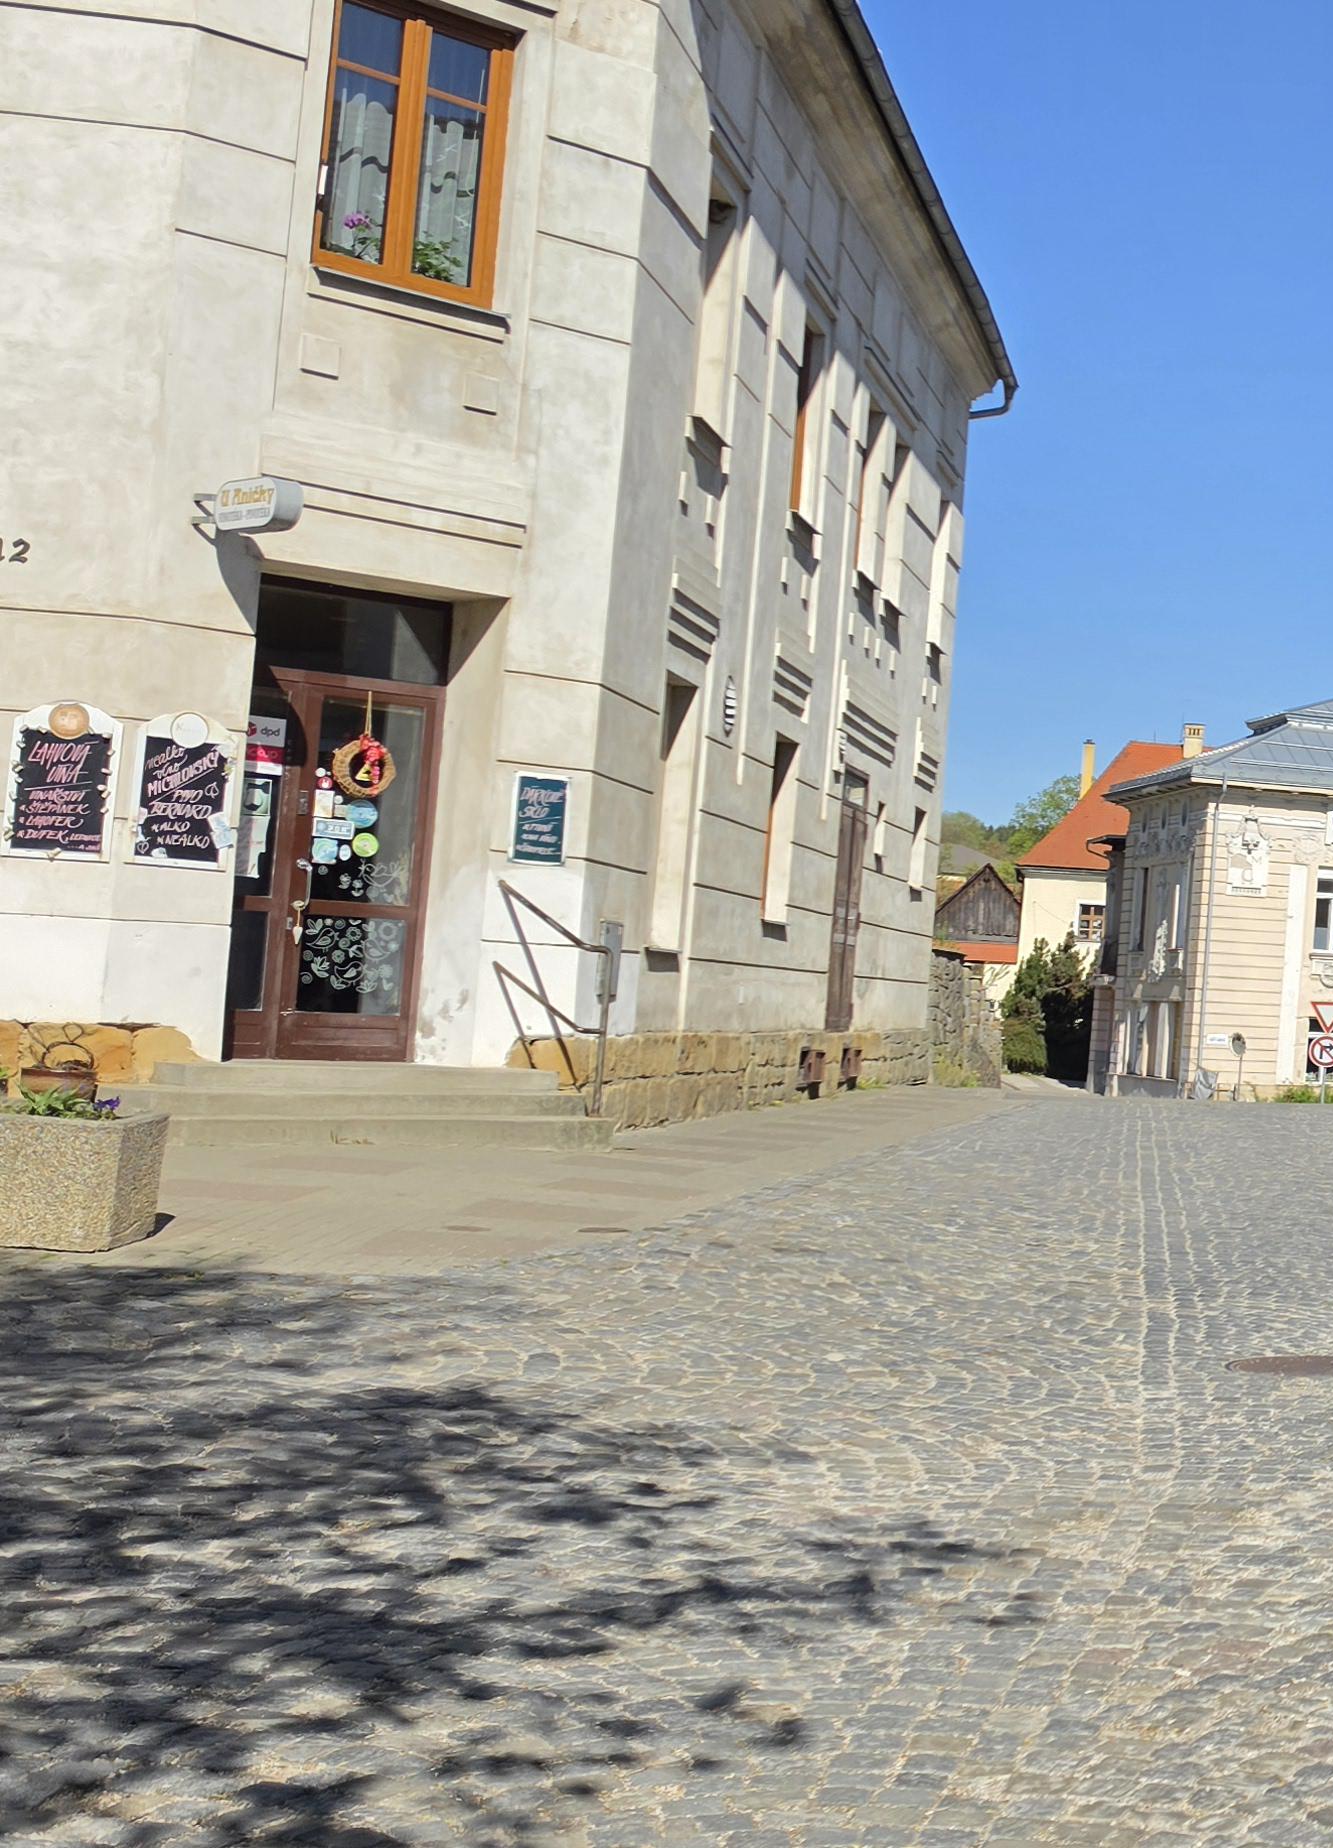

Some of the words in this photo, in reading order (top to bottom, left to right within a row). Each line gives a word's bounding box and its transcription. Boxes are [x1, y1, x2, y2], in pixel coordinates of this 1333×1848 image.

[260, 726, 281, 737] dpd
[28, 740, 99, 770] LAHVOVÁ
[46, 763, 89, 783] VÍNA
[172, 789, 203, 803] PIVO
[149, 801, 212, 819] BERNARD
[160, 821, 190, 832] ALKO
[166, 834, 210, 849] NEALKO
